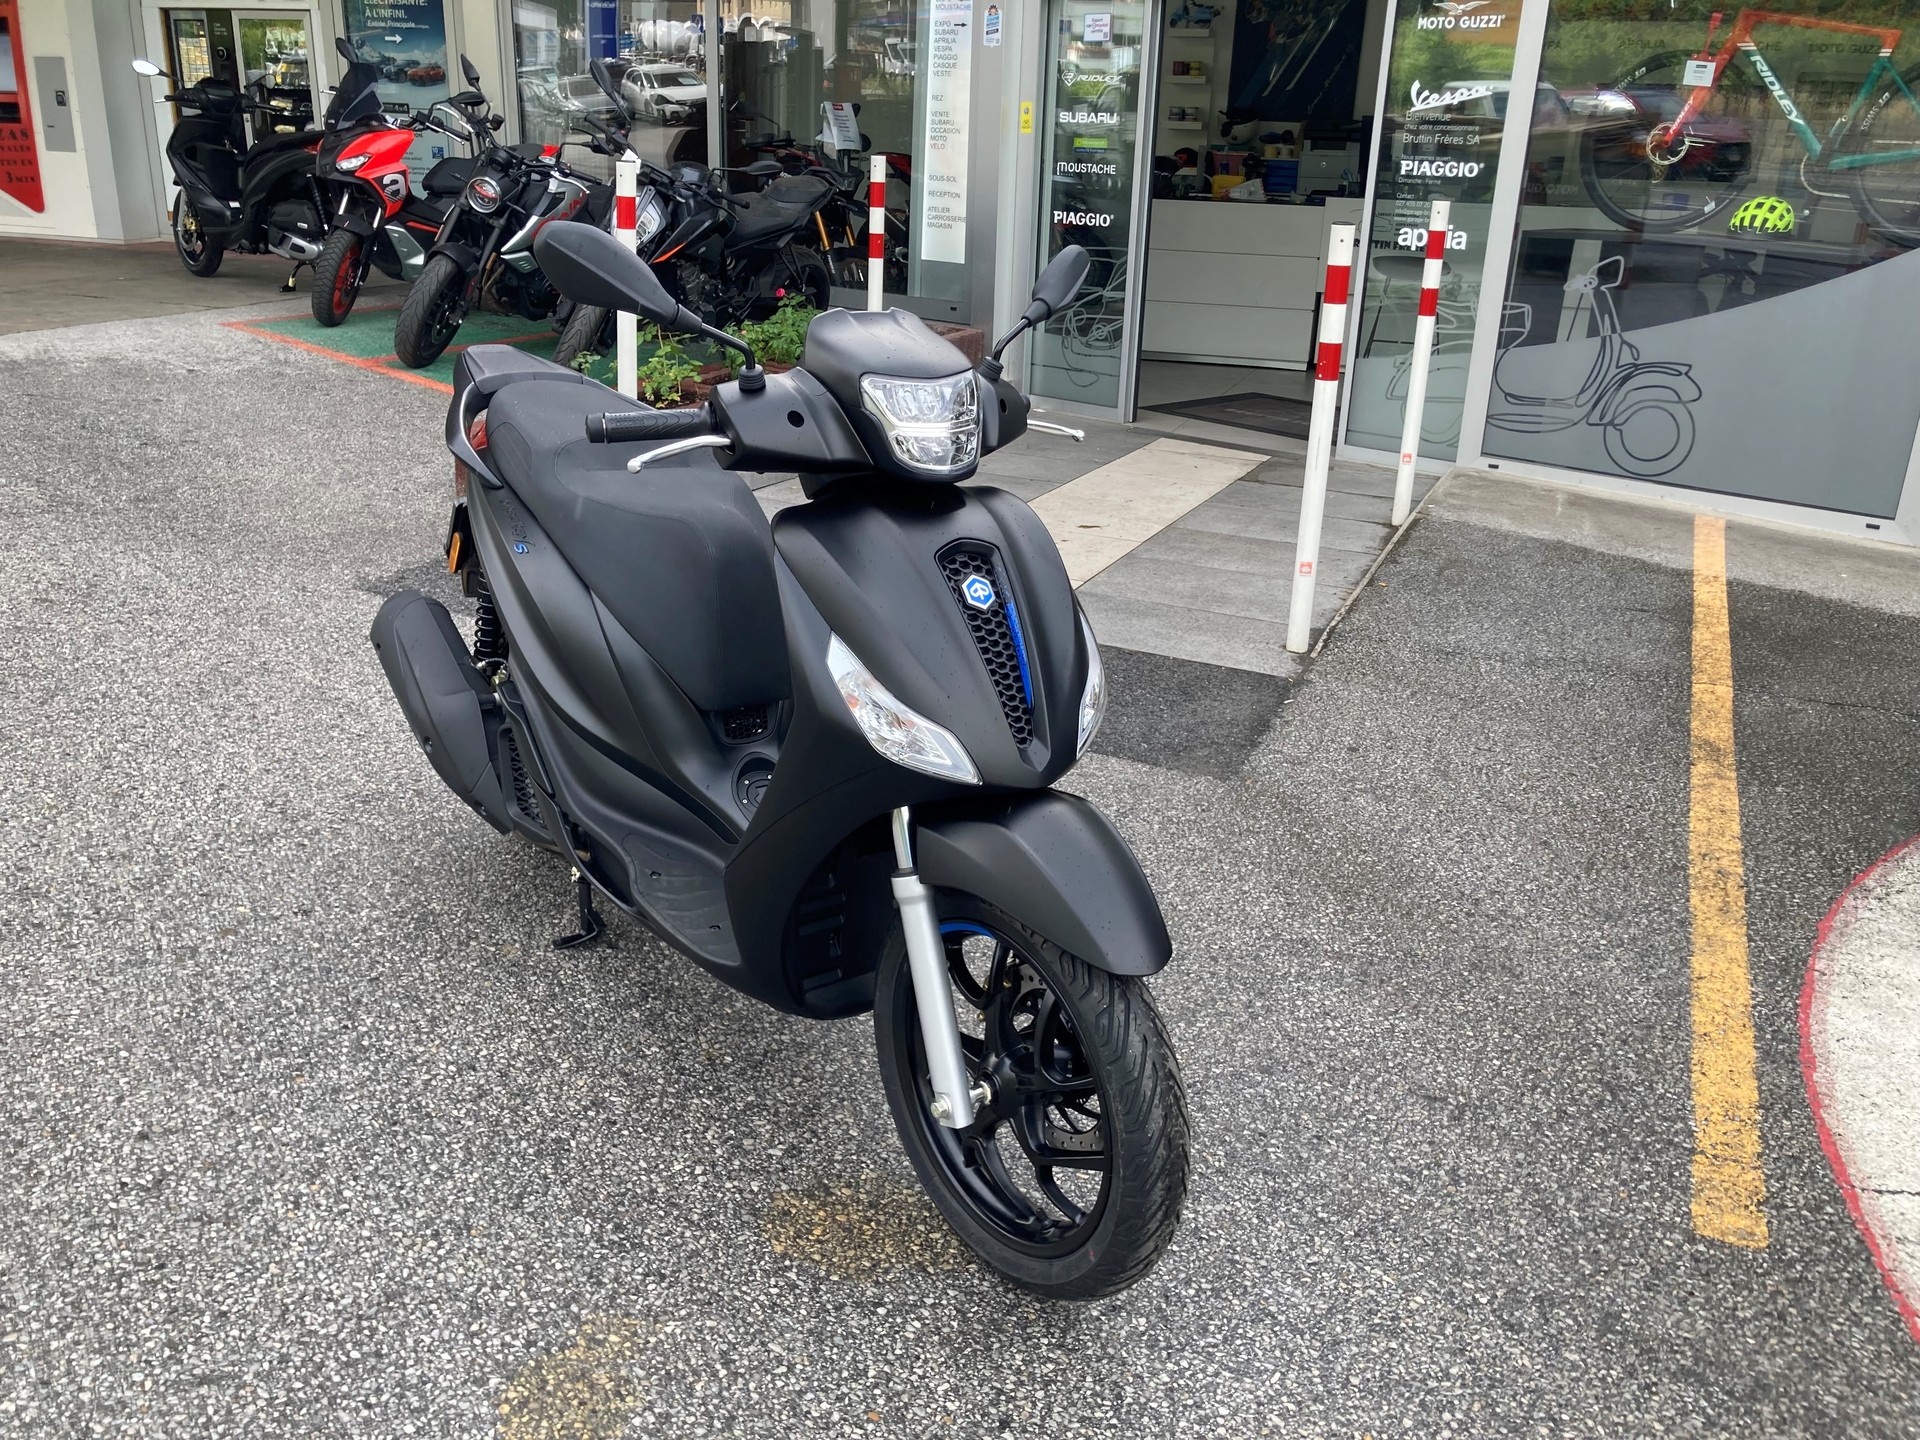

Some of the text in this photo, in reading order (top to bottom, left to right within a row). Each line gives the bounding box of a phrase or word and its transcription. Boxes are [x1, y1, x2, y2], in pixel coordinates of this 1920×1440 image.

[1417, 14, 1502, 29] MOTO GUZZI
[1077, 74, 1122, 83] RIDLEY
[1410, 80, 1494, 112] Vespa
[1750, 55, 1806, 125] RIDLEY
[931, 110, 950, 118] VENTE
[1059, 111, 1117, 124] SUBARU
[1405, 110, 1452, 121] Bienvenue
[1404, 123, 1418, 131] chez
[1434, 124, 1480, 132] concessionnaire
[1402, 132, 1480, 145] Bruttin Frères SA
[1057, 161, 1117, 175] MOUSTACHE
[1400, 160, 1479, 178] PIAGGIO
[928, 174, 957, 182] SOUS-SOL
[928, 190, 961, 198] RECEPTION
[927, 214, 967, 223] CARROSSERIE
[1053, 210, 1110, 227] PIAGGIO
[927, 222, 953, 230] MAGASIN
[1397, 224, 1468, 251] apia
